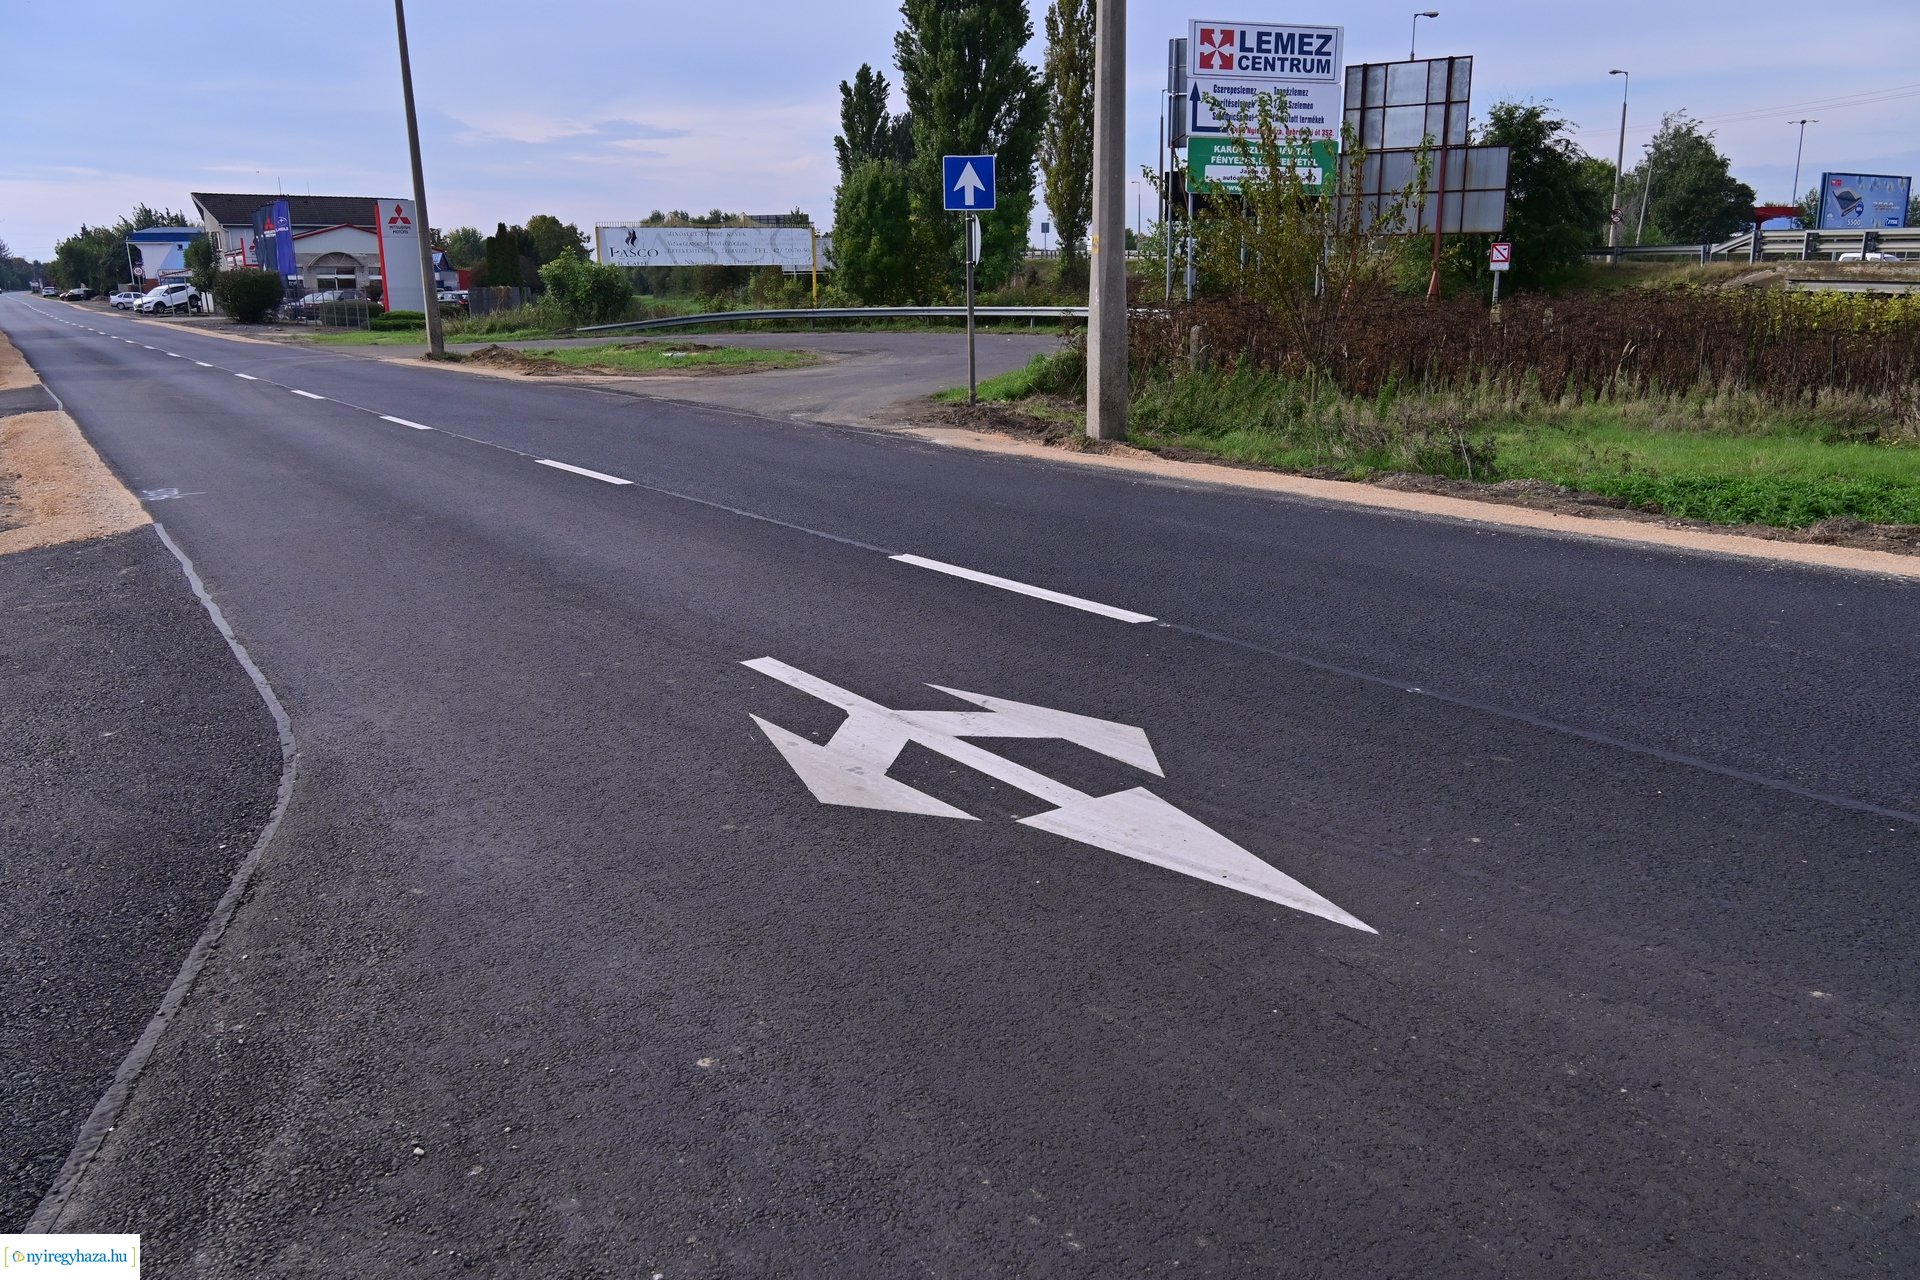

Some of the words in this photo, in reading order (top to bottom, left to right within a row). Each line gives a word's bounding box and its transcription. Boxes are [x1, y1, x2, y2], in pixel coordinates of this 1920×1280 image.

[1239, 30, 1333, 57] LEMEZ
[1237, 55, 1331, 74] CENTRUM
[1213, 84, 1257, 95] Cserepeslemez
